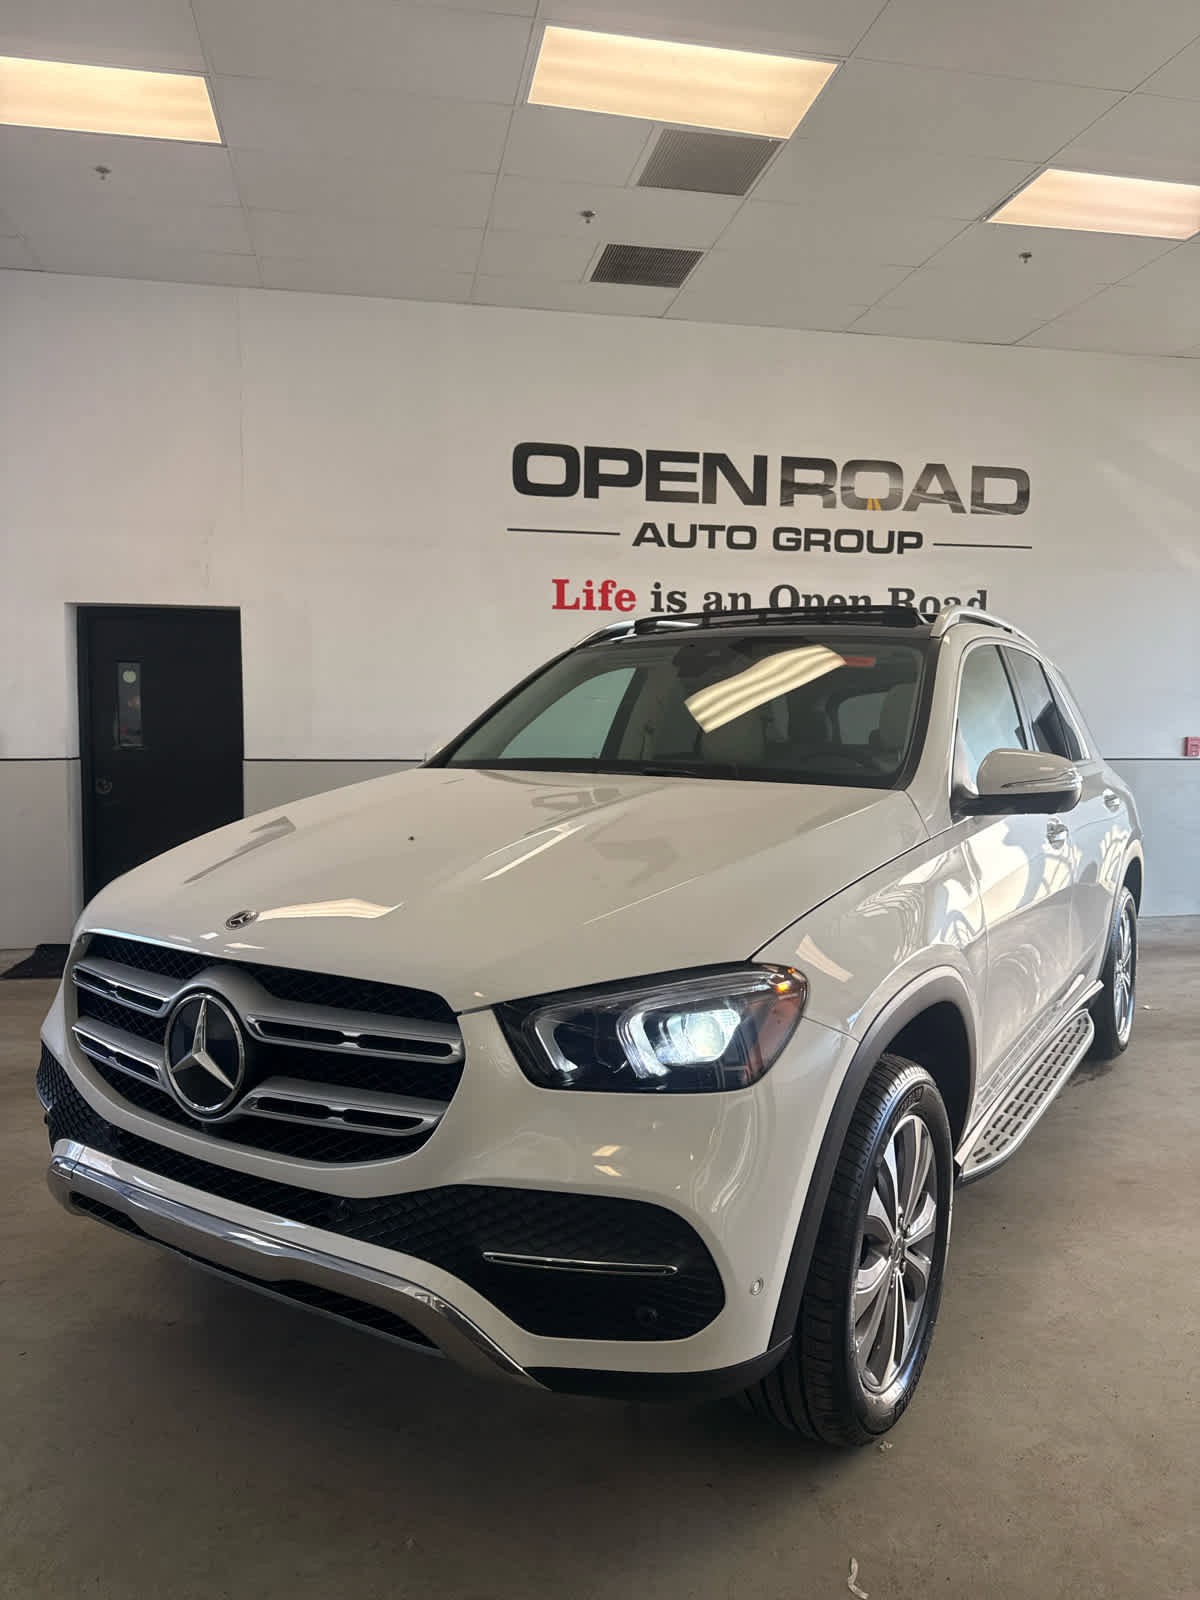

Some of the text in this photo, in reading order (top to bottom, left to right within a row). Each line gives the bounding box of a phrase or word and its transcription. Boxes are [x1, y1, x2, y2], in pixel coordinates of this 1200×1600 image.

[512, 442, 1030, 515] OPEN ROAD
[632, 522, 923, 555] AUTO GROUP
[551, 578, 637, 612] Life
[650, 582, 687, 613] is
[703, 591, 752, 612] an
